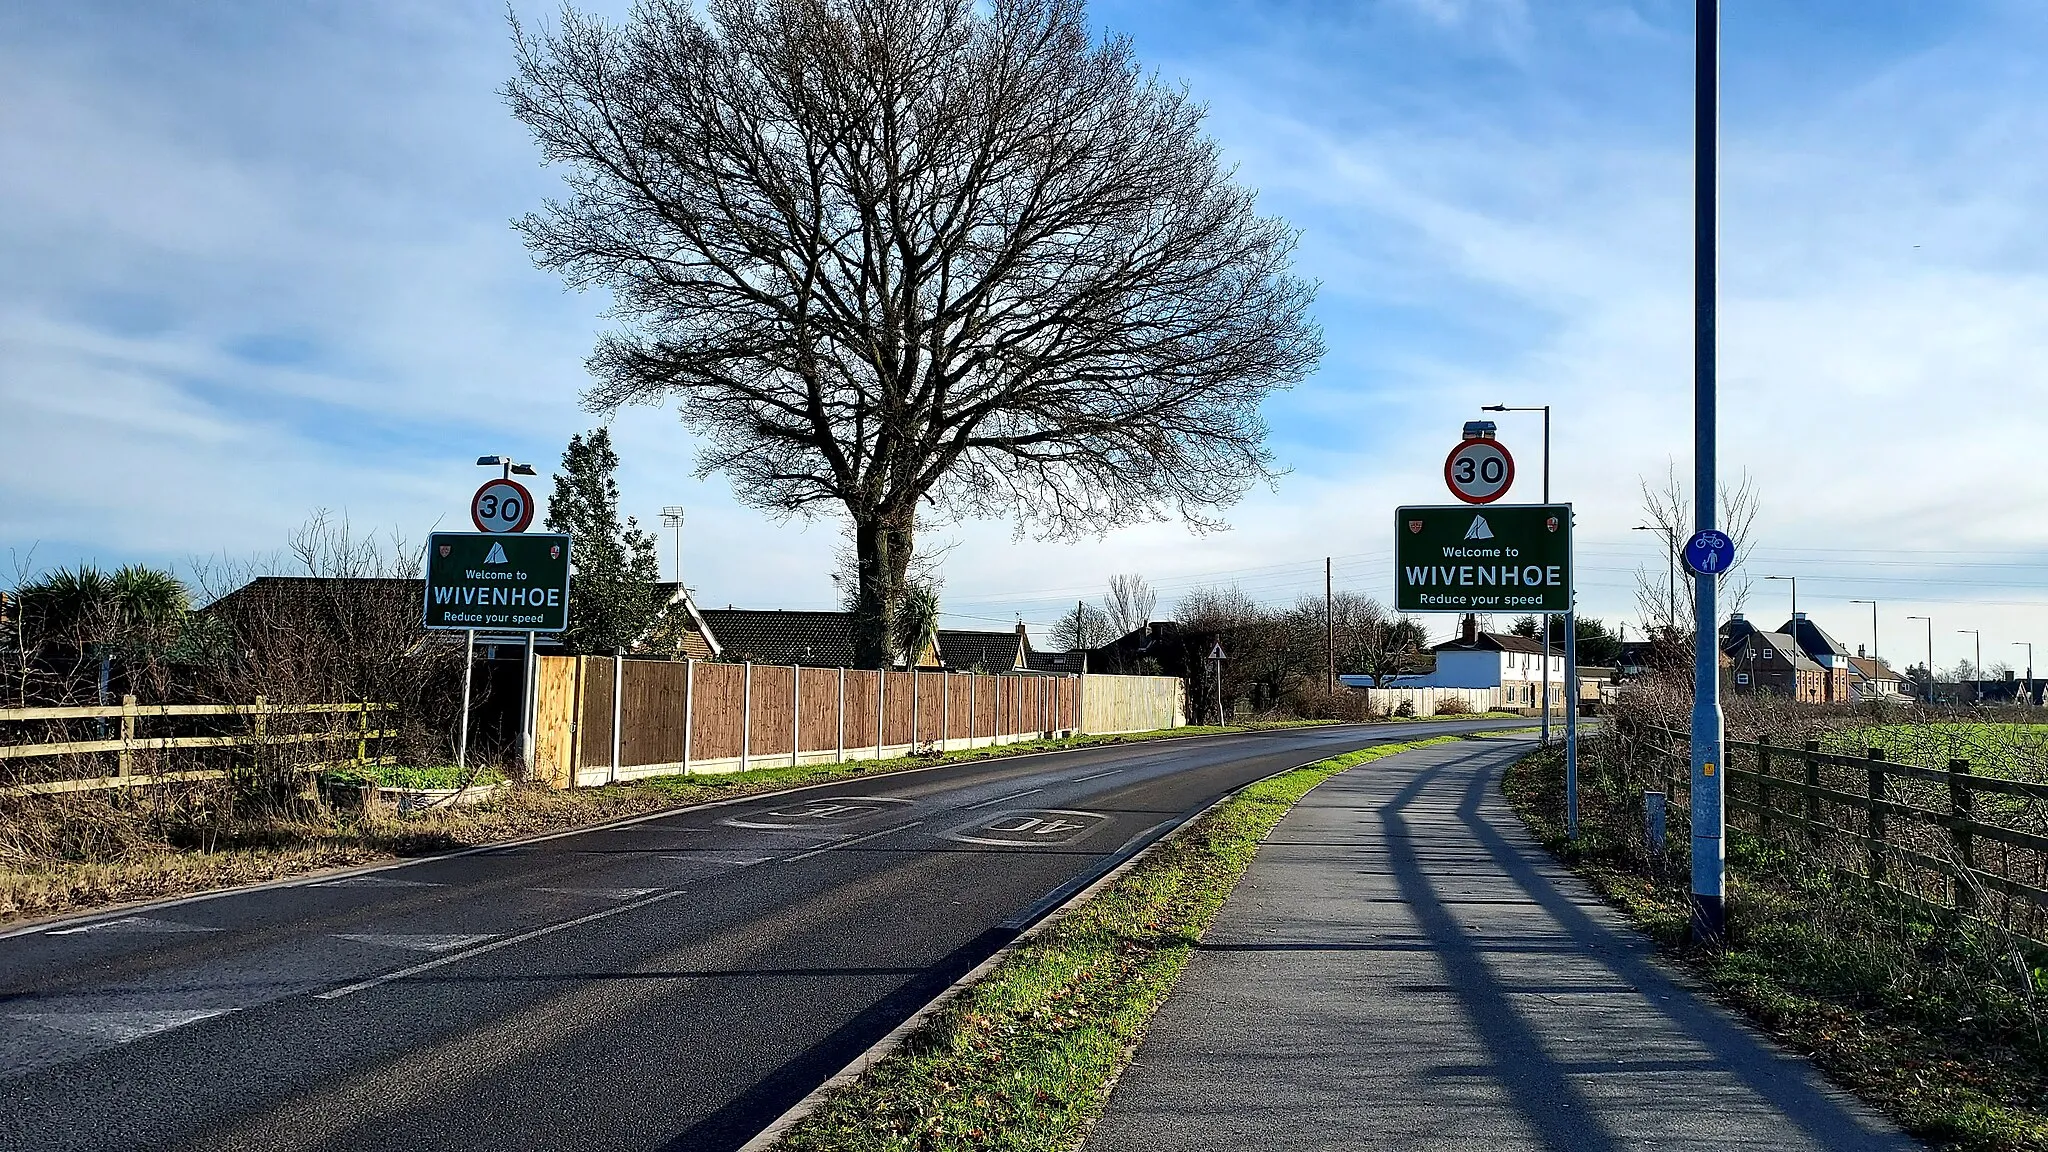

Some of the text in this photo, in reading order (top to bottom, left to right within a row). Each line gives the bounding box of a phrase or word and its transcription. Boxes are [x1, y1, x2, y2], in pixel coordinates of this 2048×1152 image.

[1454, 456, 1505, 484] 30
[479, 494, 522, 522] 30
[1442, 546, 1519, 557] Welcome to
[465, 569, 528, 580] Welcome to
[1405, 565, 1562, 586] WIVENHOE
[434, 586, 560, 607] WIVENHOE
[1420, 594, 1543, 606] Reduce your speed
[444, 612, 544, 624] Reduce your speed
